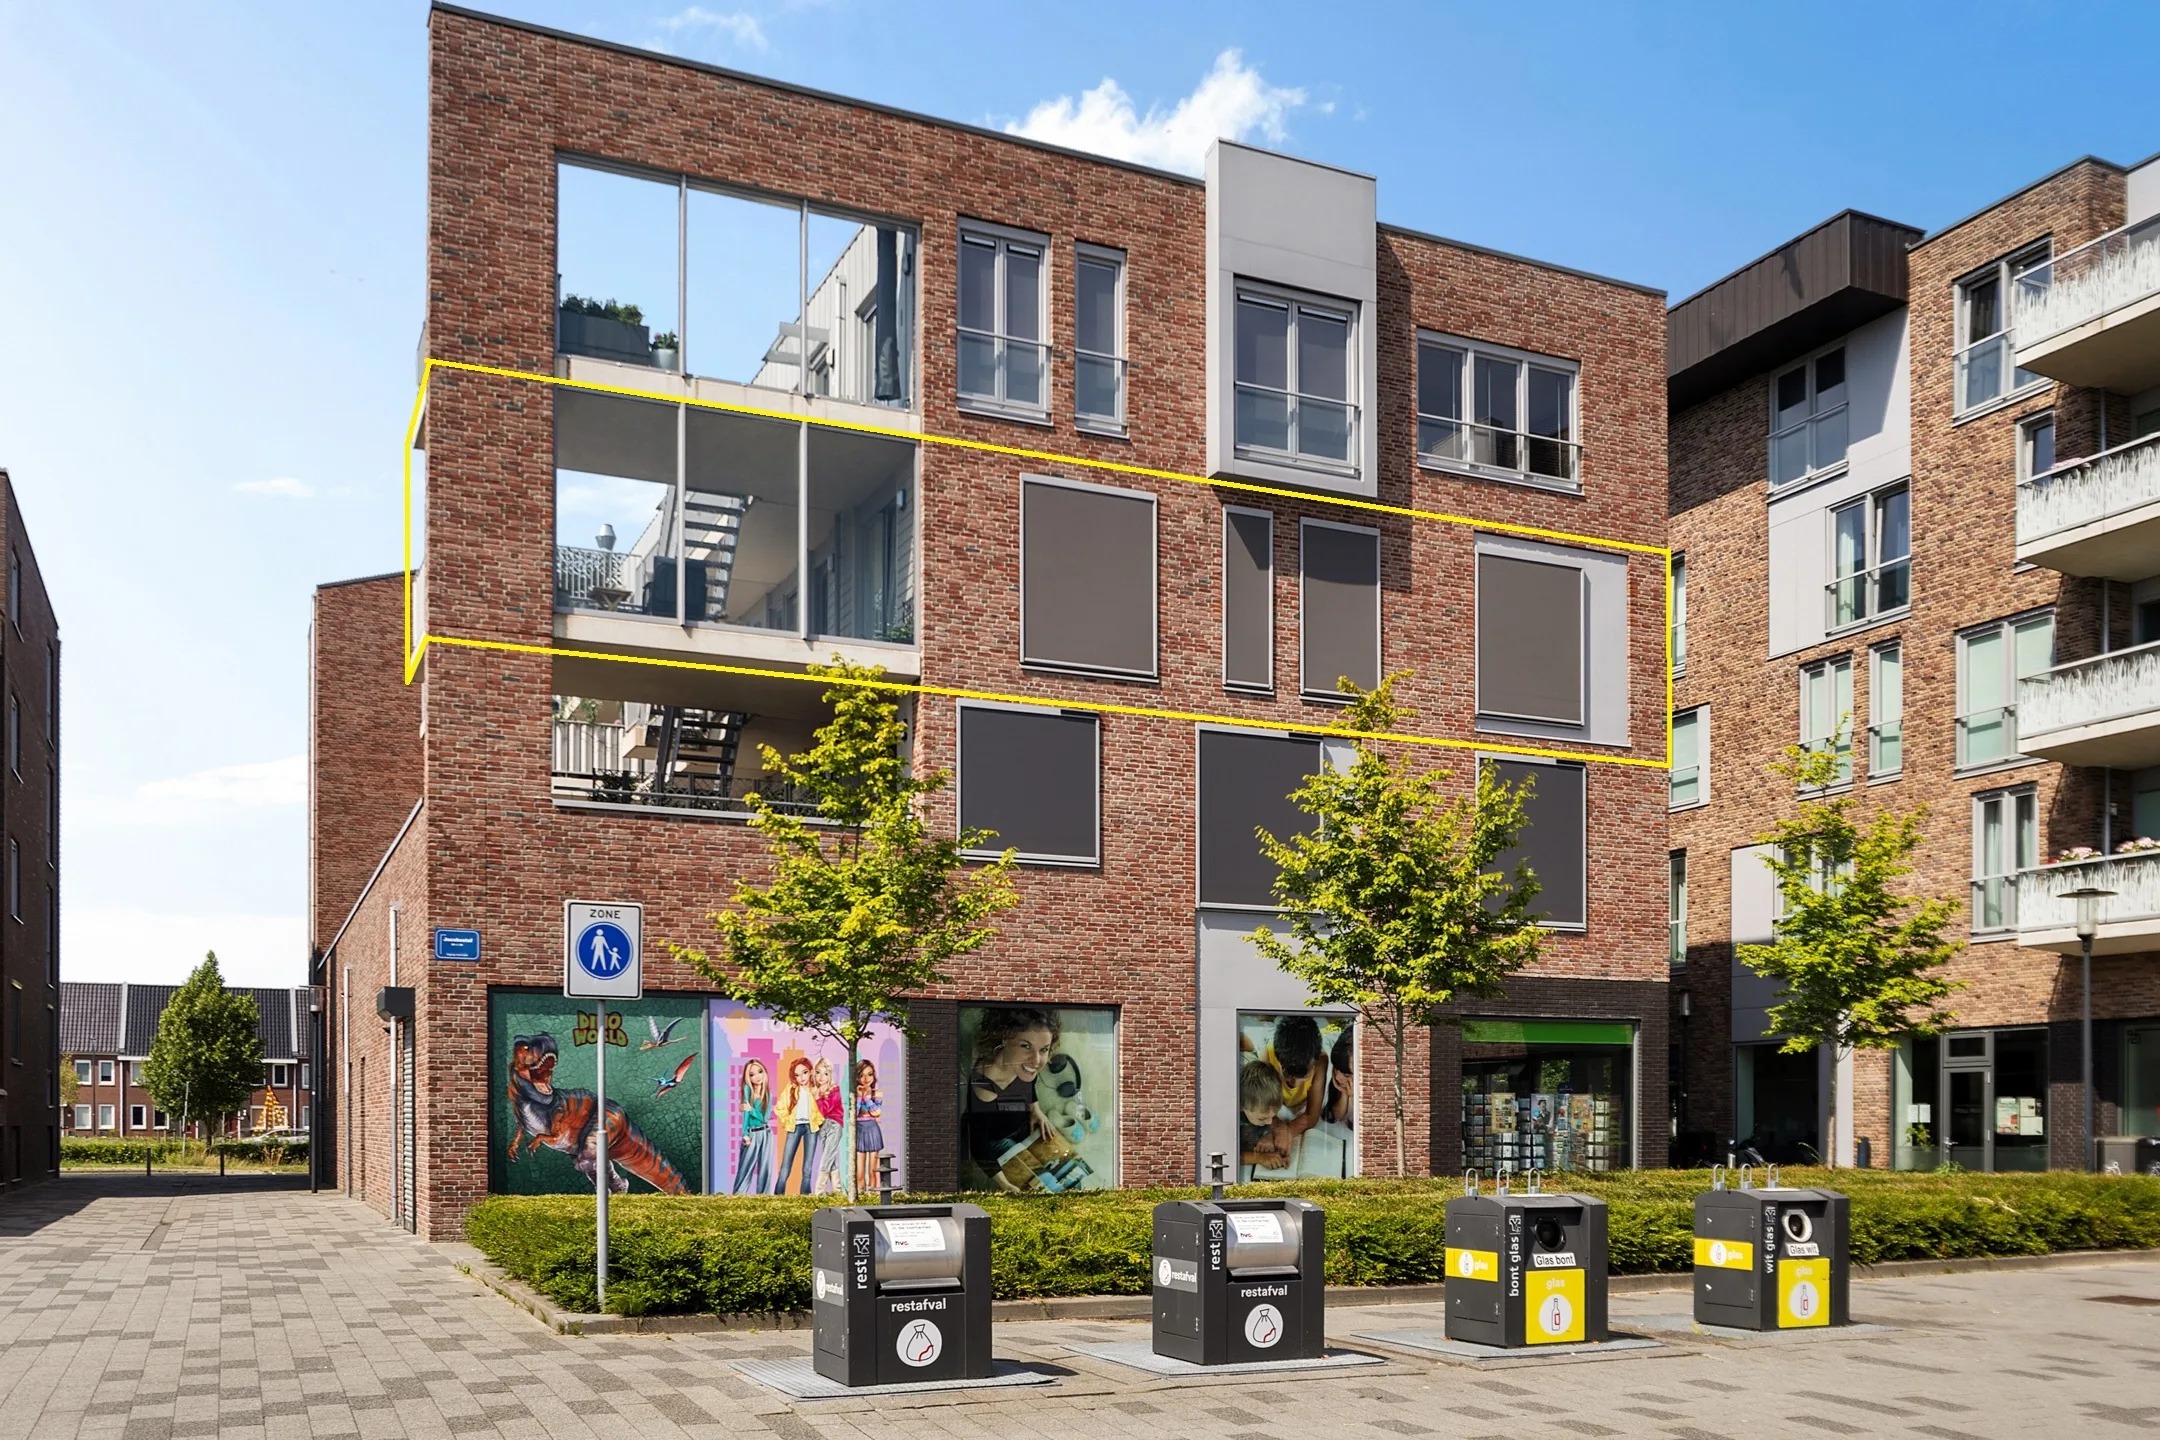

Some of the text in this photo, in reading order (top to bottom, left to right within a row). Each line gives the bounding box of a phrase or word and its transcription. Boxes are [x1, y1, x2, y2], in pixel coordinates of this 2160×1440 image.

[589, 908, 621, 919] ZONE
[1211, 1242, 1221, 1271] rest
[1726, 1250, 1744, 1261] glas
[1765, 1226, 1776, 1274] wit glas
[1789, 1245, 1805, 1255] Glas
[1473, 1260, 1489, 1272] glas
[1509, 1236, 1521, 1297] bont glas
[1535, 1253, 1573, 1267] Glas bont
[854, 1258, 867, 1290] rest
[1171, 1270, 1197, 1283] restafval
[1795, 1266, 1813, 1277] glas
[1546, 1278, 1566, 1290] glas
[1240, 1285, 1288, 1298] restafval
[891, 1297, 947, 1313] restafval
